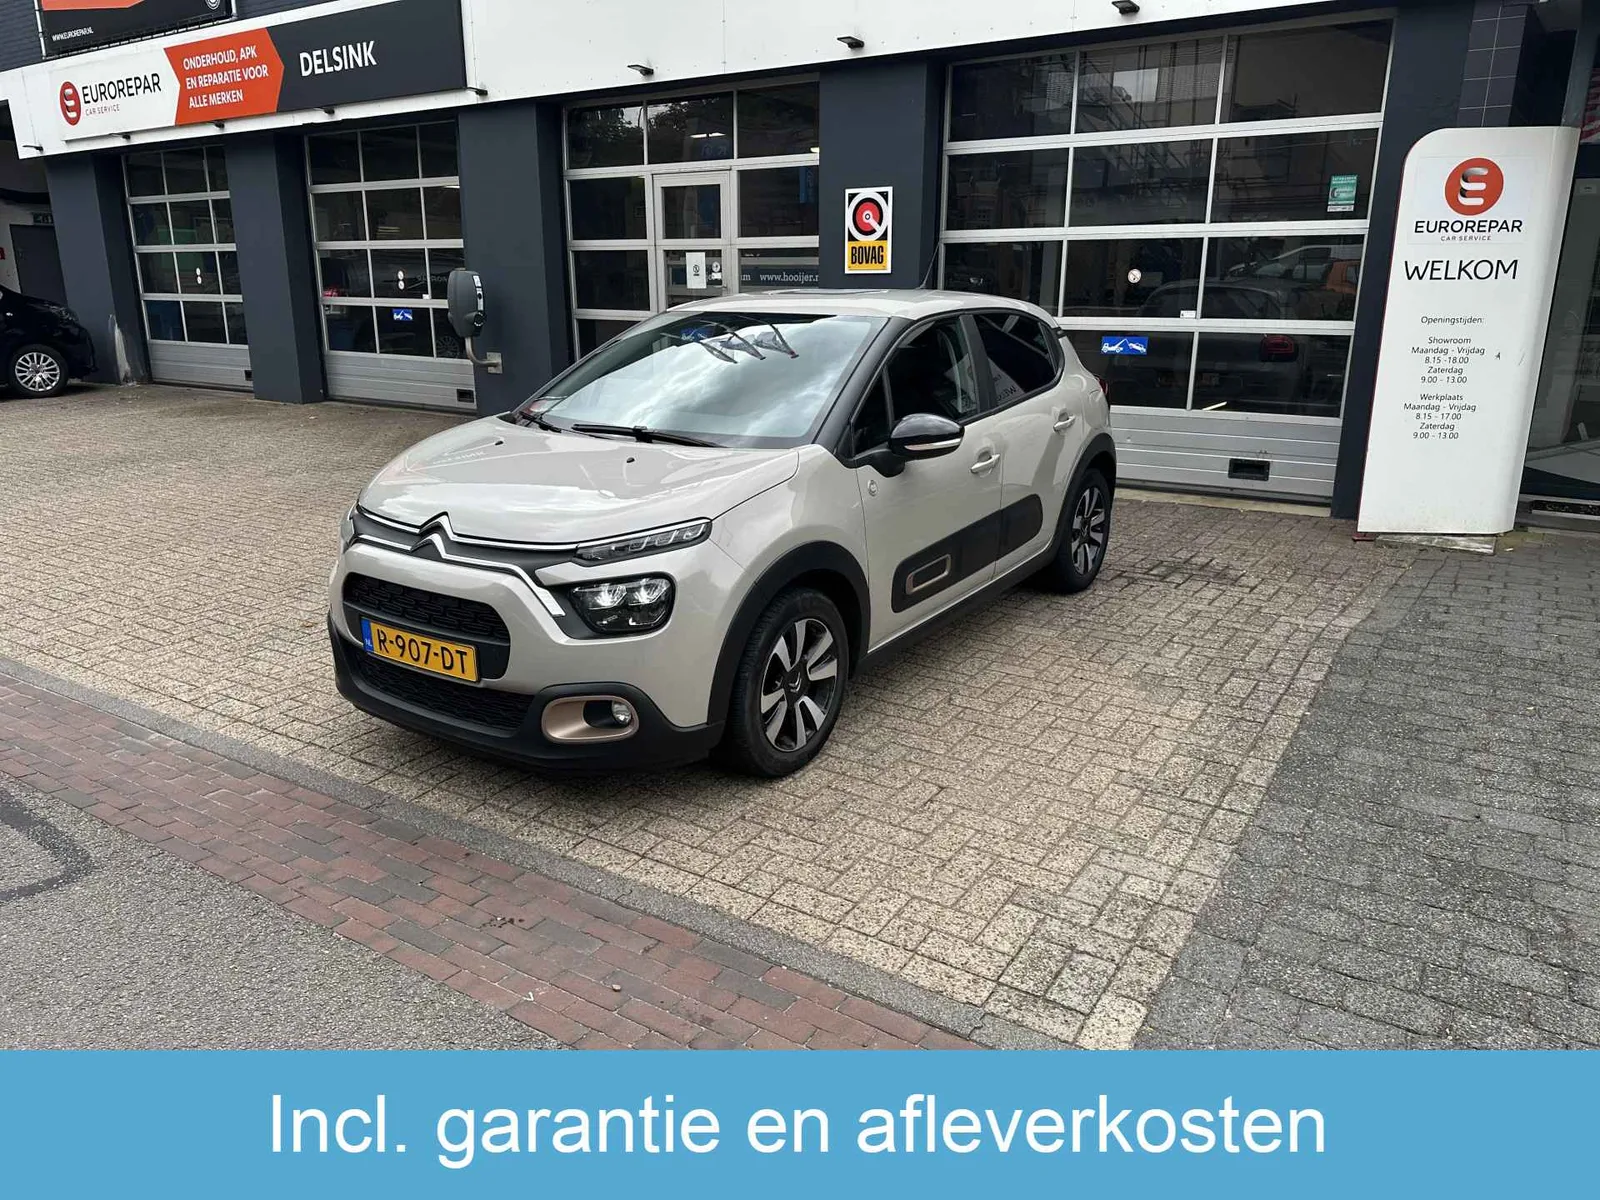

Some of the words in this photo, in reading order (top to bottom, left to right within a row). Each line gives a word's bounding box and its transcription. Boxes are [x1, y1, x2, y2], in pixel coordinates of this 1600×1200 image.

[183, 49, 239, 71] ONDERHOUD,
[239, 45, 258, 61] APK
[299, 40, 377, 77] DELSINK
[185, 77, 197, 90] EN
[197, 69, 242, 88] REPARATIE
[243, 64, 269, 80] VOOR
[81, 72, 162, 104] EUROREPAR
[188, 94, 208, 109] ALLE
[209, 89, 244, 106] MERKEN
[85, 108, 97, 116] CAR
[97, 103, 120, 115] SERVICE
[1413, 219, 1523, 234] EUROREPAR
[850, 245, 884, 265] BOVAG
[1404, 259, 1519, 281] WELKOM
[1420, 315, 1485, 326] Openingstijden:
[1428, 336, 1472, 344] Showroom
[1411, 346, 1449, 356] Maandag
[1457, 346, 1486, 356] Vrijdag
[1424, 356, 1441, 364] 8.15
[1427, 366, 1464, 376] Zaterdag
[1420, 376, 1438, 384] 9.00
[1446, 376, 1468, 384] 13.00
[1420, 393, 1464, 403] Werkplaats
[1403, 403, 1441, 413] Maandag
[1448, 403, 1477, 413] Vrijdag
[1415, 413, 1432, 421] 8.15
[1441, 412, 1462, 421] 17.00
[1419, 422, 1456, 432] Zaterdag
[1412, 431, 1430, 440] 9.00
[1438, 431, 1459, 440] 13.00
[376, 628, 468, 674] R-907-DT
